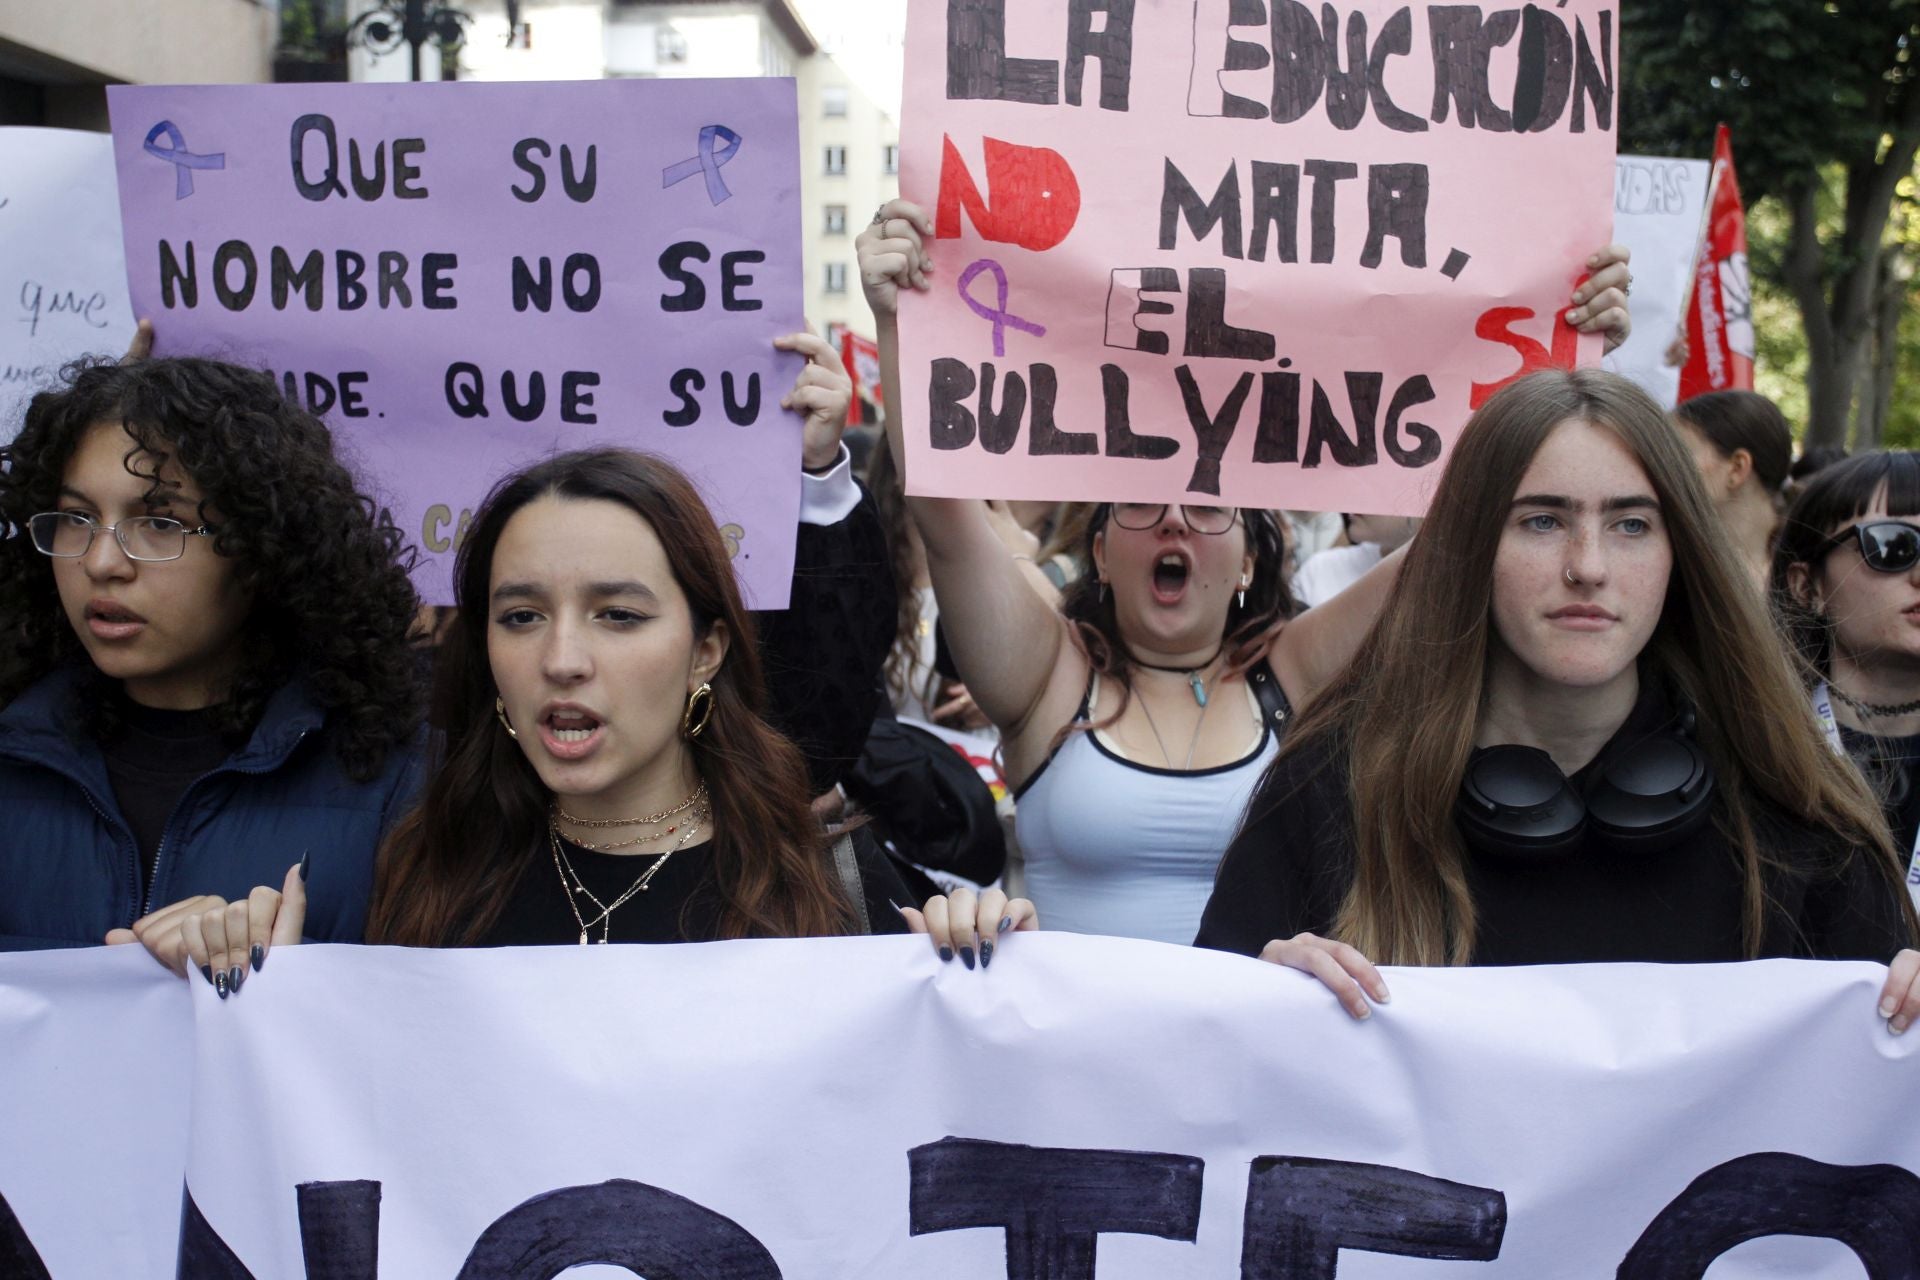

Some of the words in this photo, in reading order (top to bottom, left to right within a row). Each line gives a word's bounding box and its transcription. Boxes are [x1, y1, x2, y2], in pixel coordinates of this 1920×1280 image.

[946, 0, 1135, 112] LA
[290, 113, 429, 202] QUE
[511, 137, 597, 204] SU
[934, 133, 1081, 252] NO
[1158, 155, 1471, 282] MATA,
[158, 239, 458, 312] NOMBRE
[511, 252, 602, 313] NO
[658, 240, 766, 313] SE
[1104, 266, 1276, 362] EL
[444, 361, 601, 425] QUE
[662, 367, 762, 428] SU
[928, 355, 1442, 497] BULLYING
